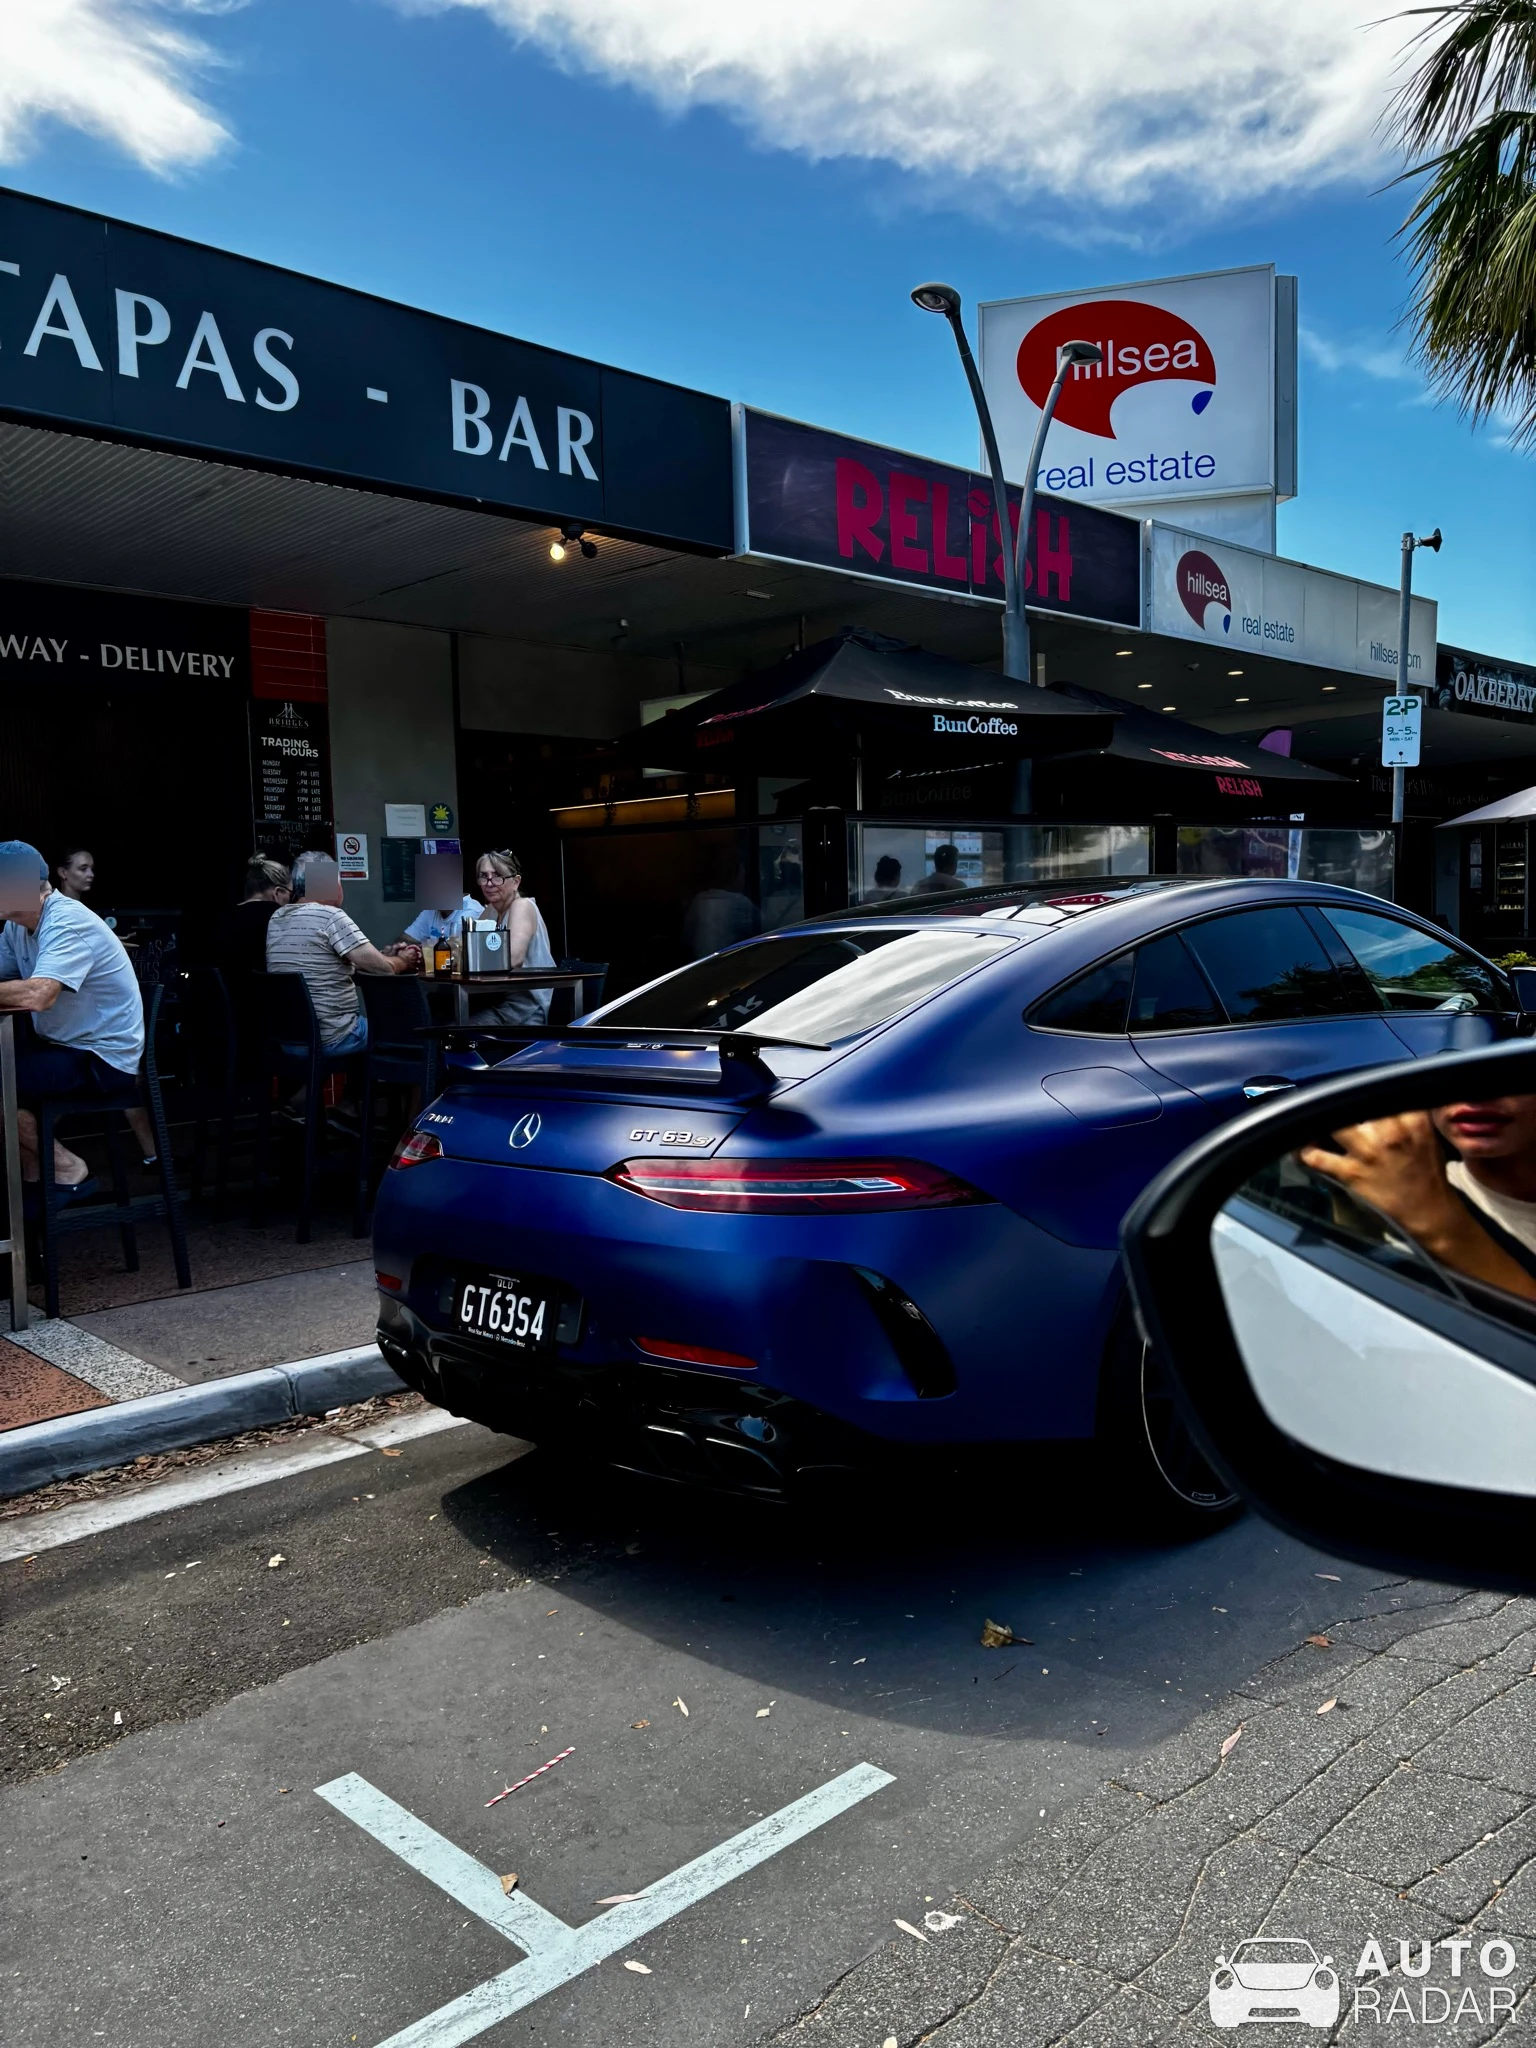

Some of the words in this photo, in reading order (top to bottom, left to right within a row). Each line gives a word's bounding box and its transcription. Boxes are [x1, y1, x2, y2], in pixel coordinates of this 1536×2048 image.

[450, 378, 599, 481] BAR
[1035, 457, 1093, 491] real
[1106, 450, 1215, 484] estate
[1187, 570, 1228, 601] hillsea
[1242, 615, 1261, 636] real
[1264, 620, 1295, 643] estate
[100, 643, 235, 679] DELIVERY
[1370, 641, 1421, 669] hillseaom
[1454, 671, 1536, 713] OAKBERRY
[1386, 698, 1418, 715] 2P
[268, 717, 310, 728] BRIDGES
[932, 714, 1018, 735] BunCoffee
[260, 736, 310, 749] TRADING
[282, 747, 319, 758] HOURS
[629, 1129, 659, 1142] GT
[497, 1279, 514, 1290] QLD
[461, 1284, 547, 1342] GT63S4
